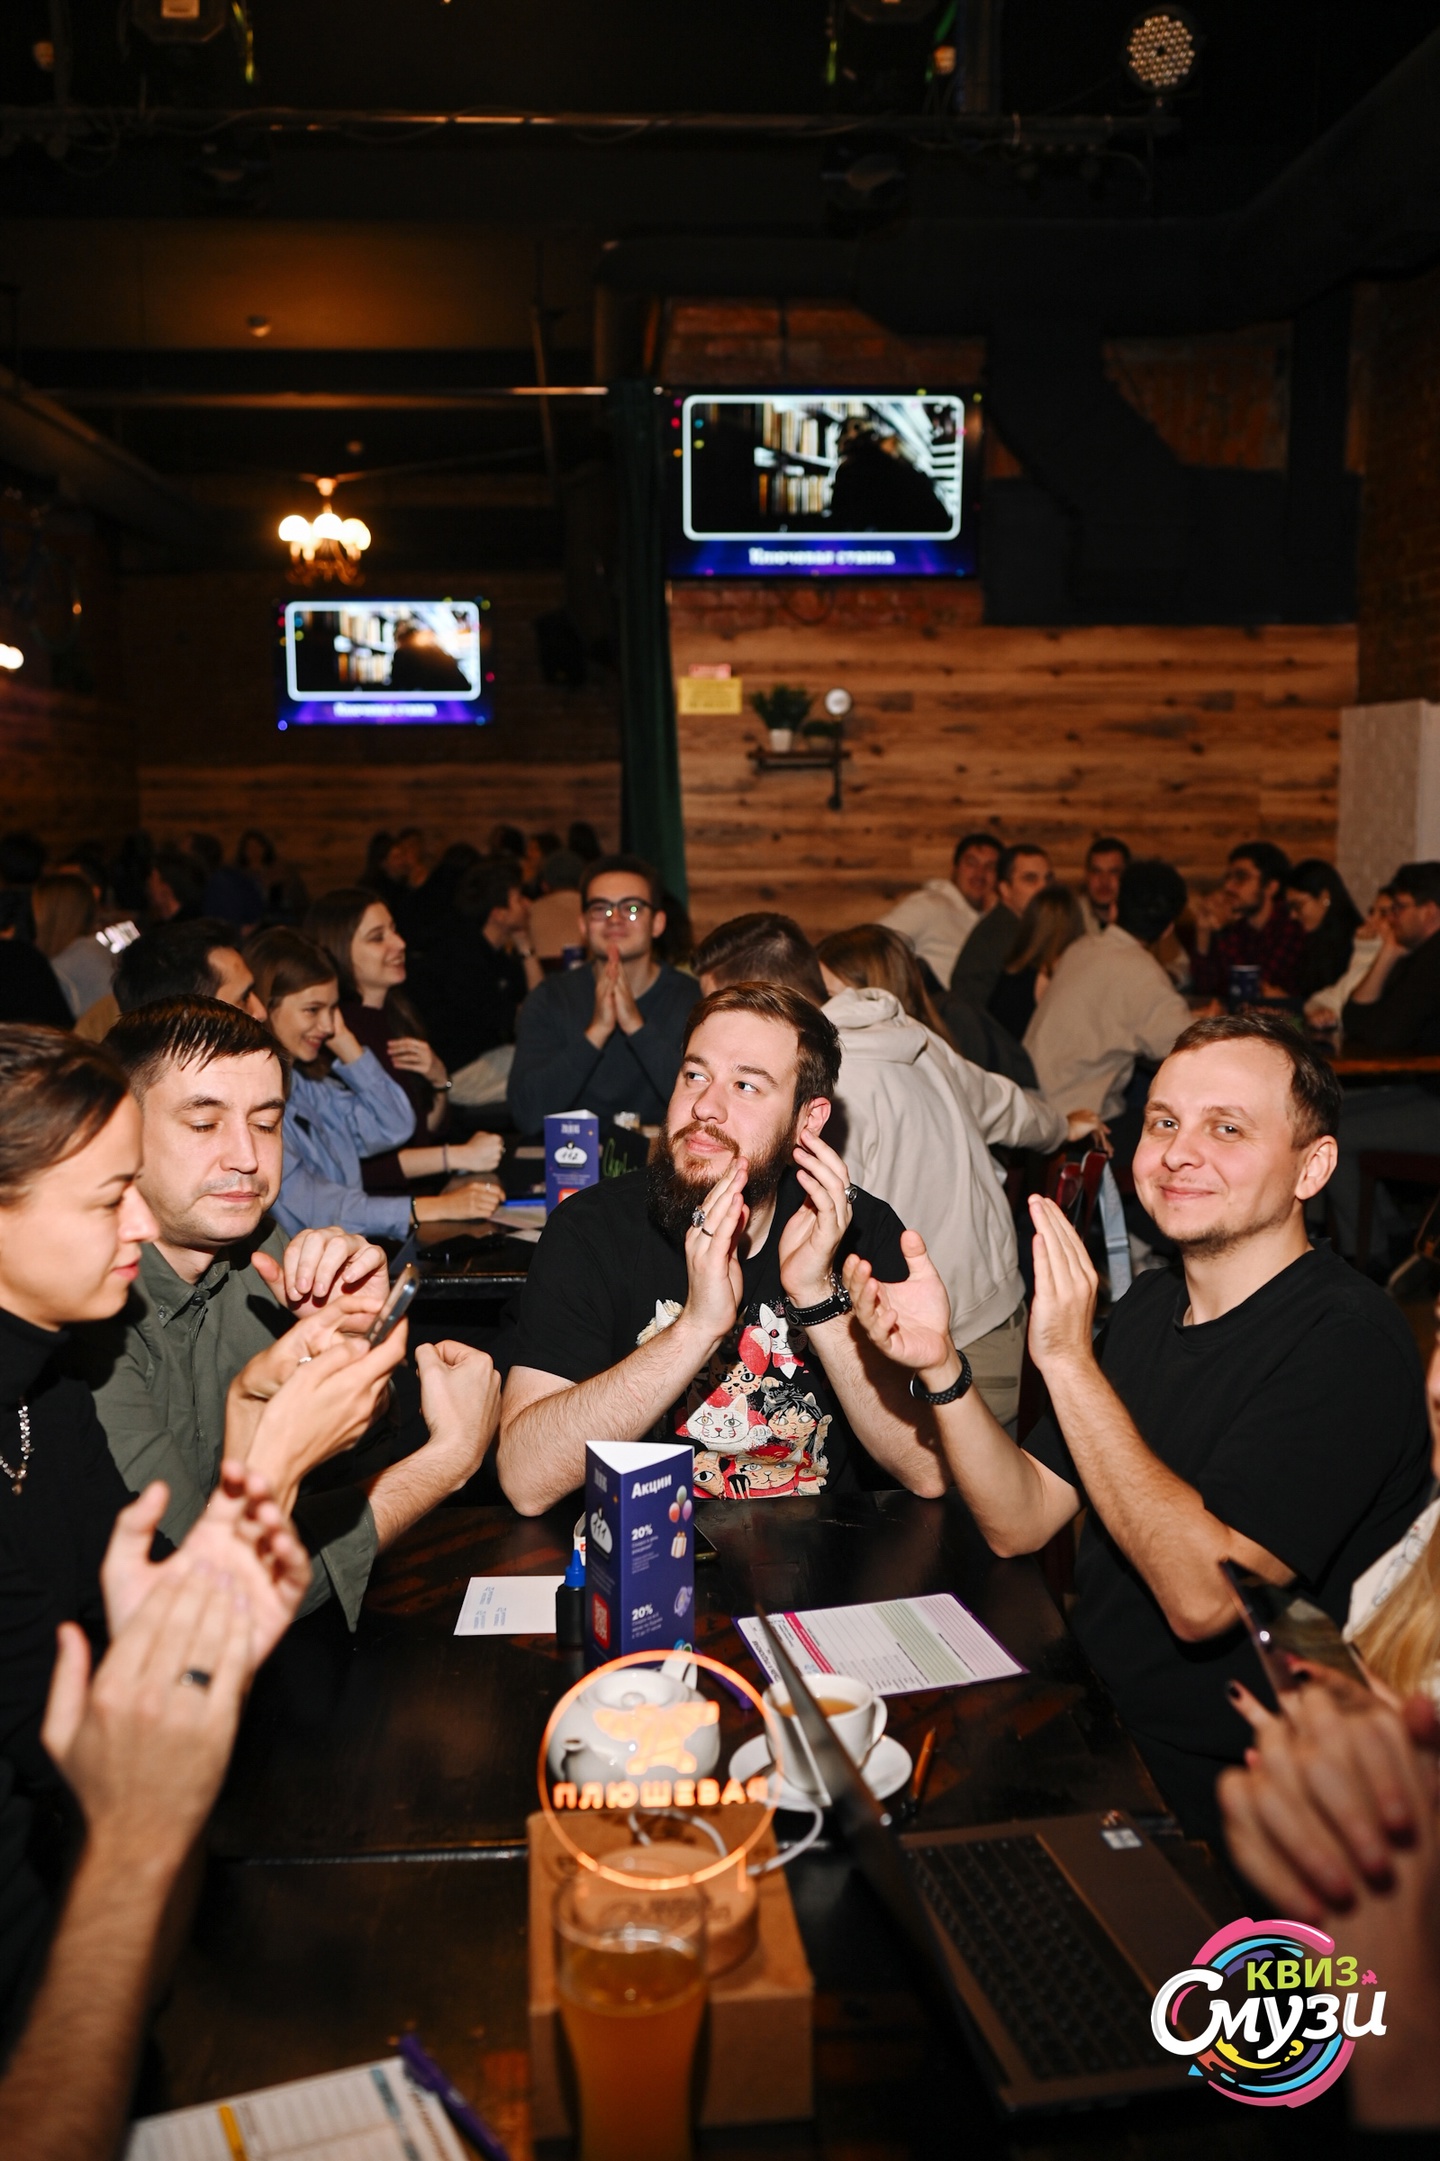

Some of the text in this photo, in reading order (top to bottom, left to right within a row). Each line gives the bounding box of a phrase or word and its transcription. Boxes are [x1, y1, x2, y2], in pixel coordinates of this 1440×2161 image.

[631, 1474, 672, 1499] Акции
[631, 1523, 653, 1541] 20%
[631, 1603, 653, 1621] 20%
